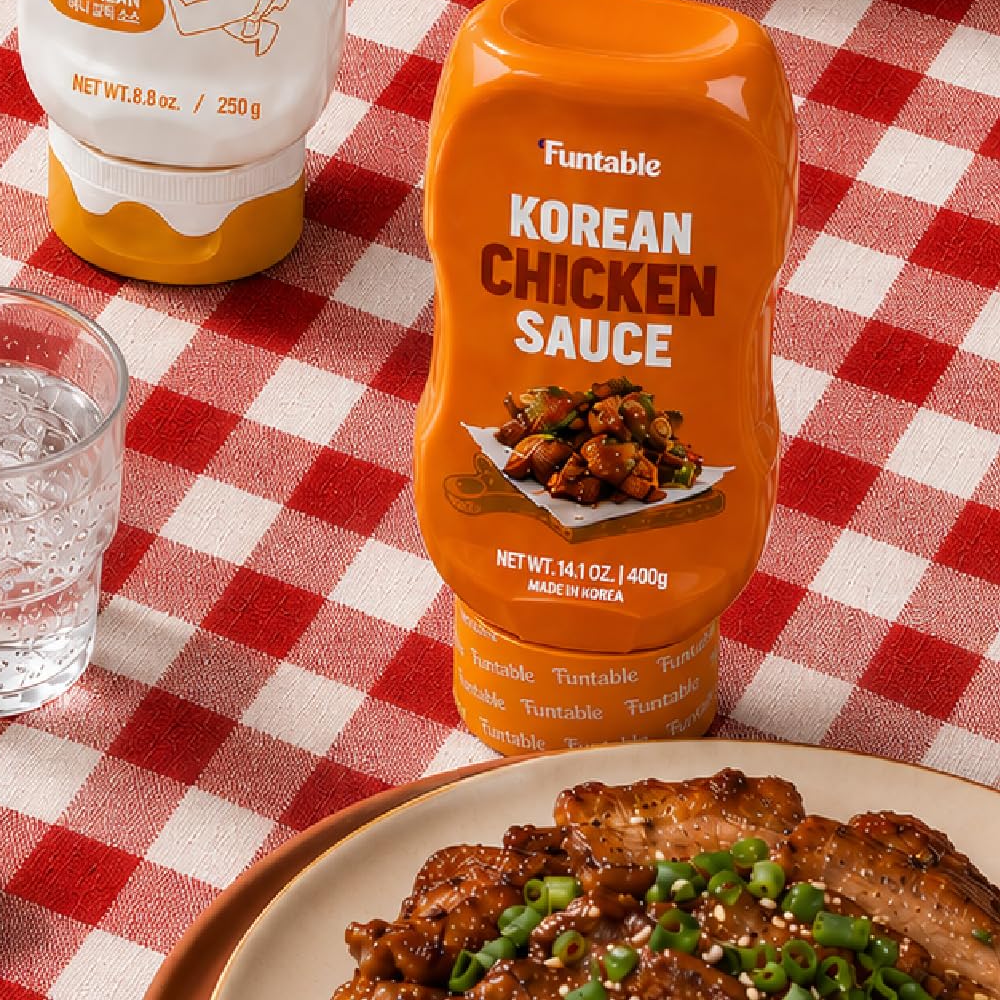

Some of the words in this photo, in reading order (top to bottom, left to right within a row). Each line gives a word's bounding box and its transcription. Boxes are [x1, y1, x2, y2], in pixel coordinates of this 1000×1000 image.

[72, 73, 102, 96] NET
[543, 139, 662, 178] Funtable
[509, 192, 692, 255] KOREAN
[480, 243, 717, 317] CHICKEN
[514, 309, 673, 368] SAUCE
[496, 549, 526, 569] NET
[588, 564, 616, 583] OZ.
[626, 567, 668, 589] 400g
[527, 579, 563, 596] MADE
[566, 585, 579, 597] IN
[580, 588, 625, 603] KOREA
[470, 647, 536, 684] Funtable
[552, 667, 639, 687] Funtable
[520, 698, 603, 721] Funtable
[624, 676, 700, 716] Funtable
[479, 716, 546, 751] Funtable
